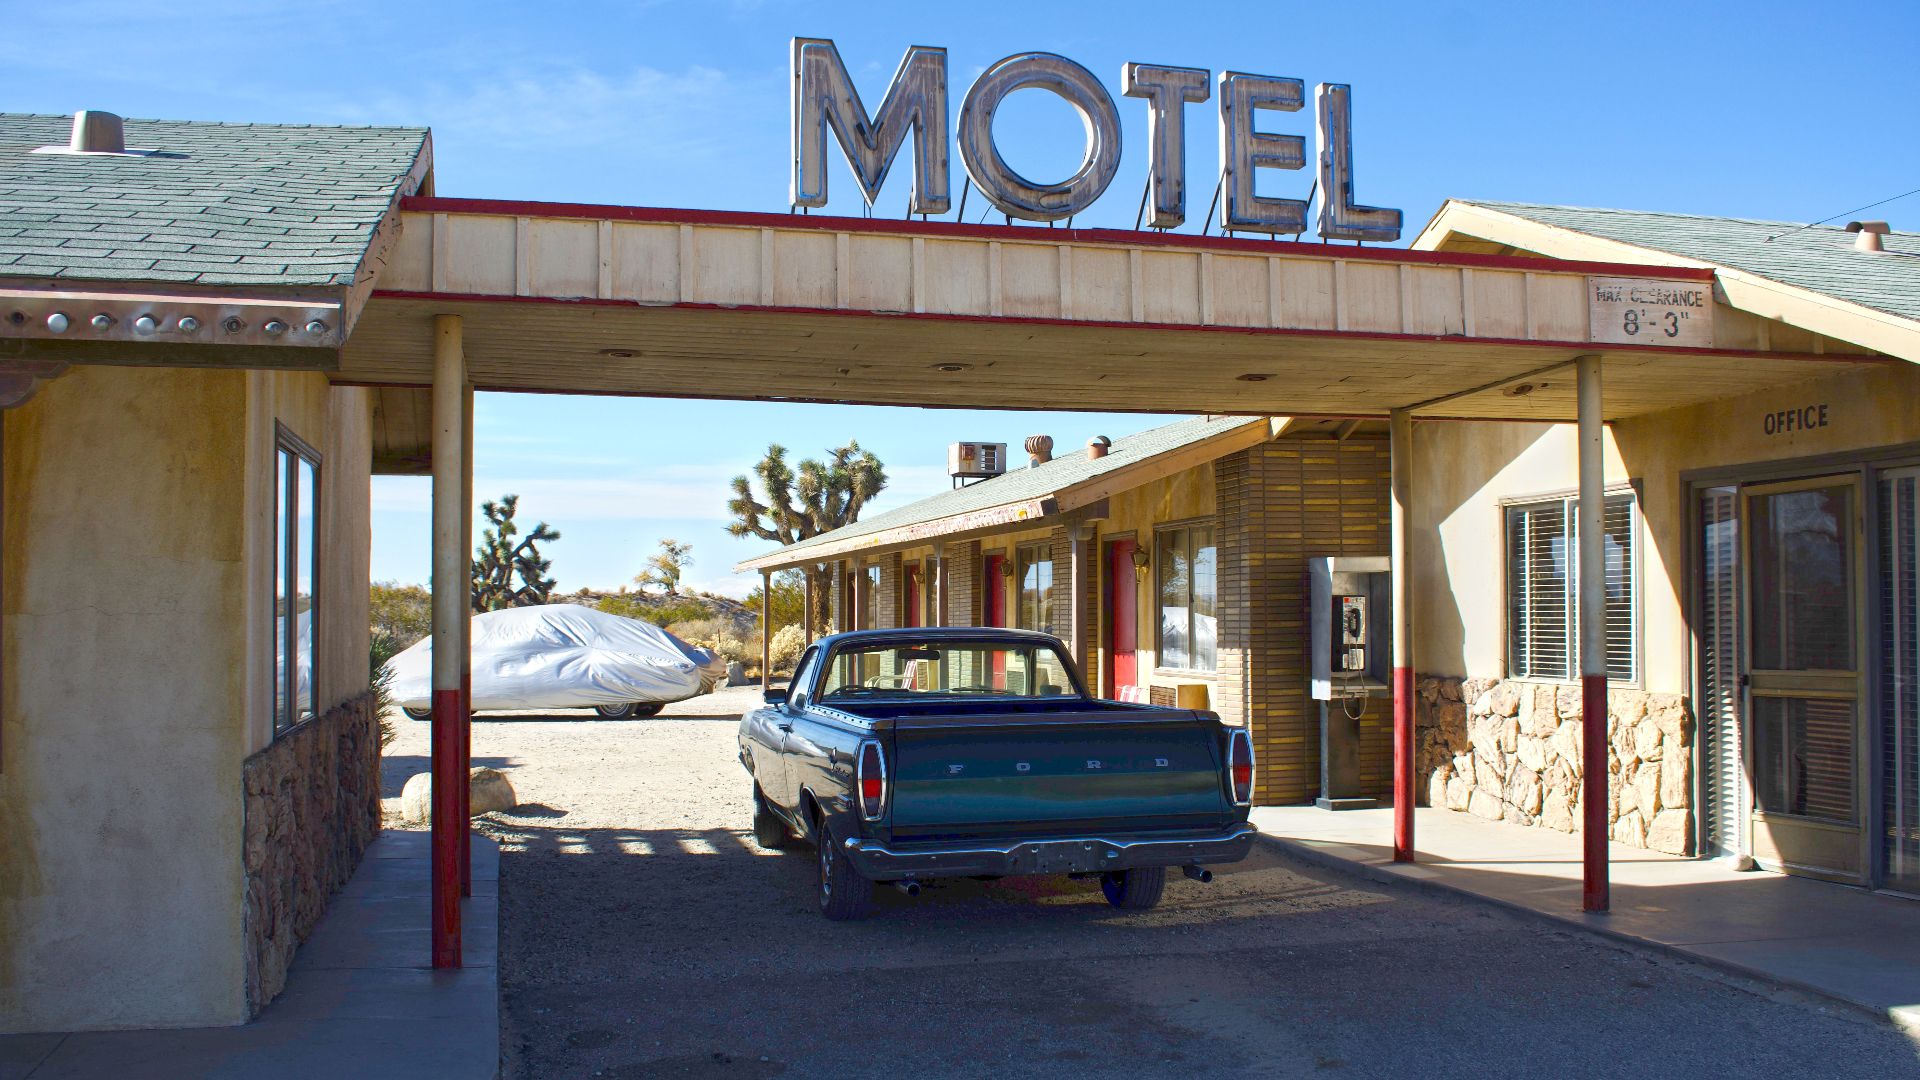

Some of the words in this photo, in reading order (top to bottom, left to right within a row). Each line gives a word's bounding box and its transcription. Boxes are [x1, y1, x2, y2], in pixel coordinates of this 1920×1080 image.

[791, 37, 1404, 241] MOTEL
[1764, 405, 1828, 435] OFFICE
[949, 758, 1169, 774] FORD
